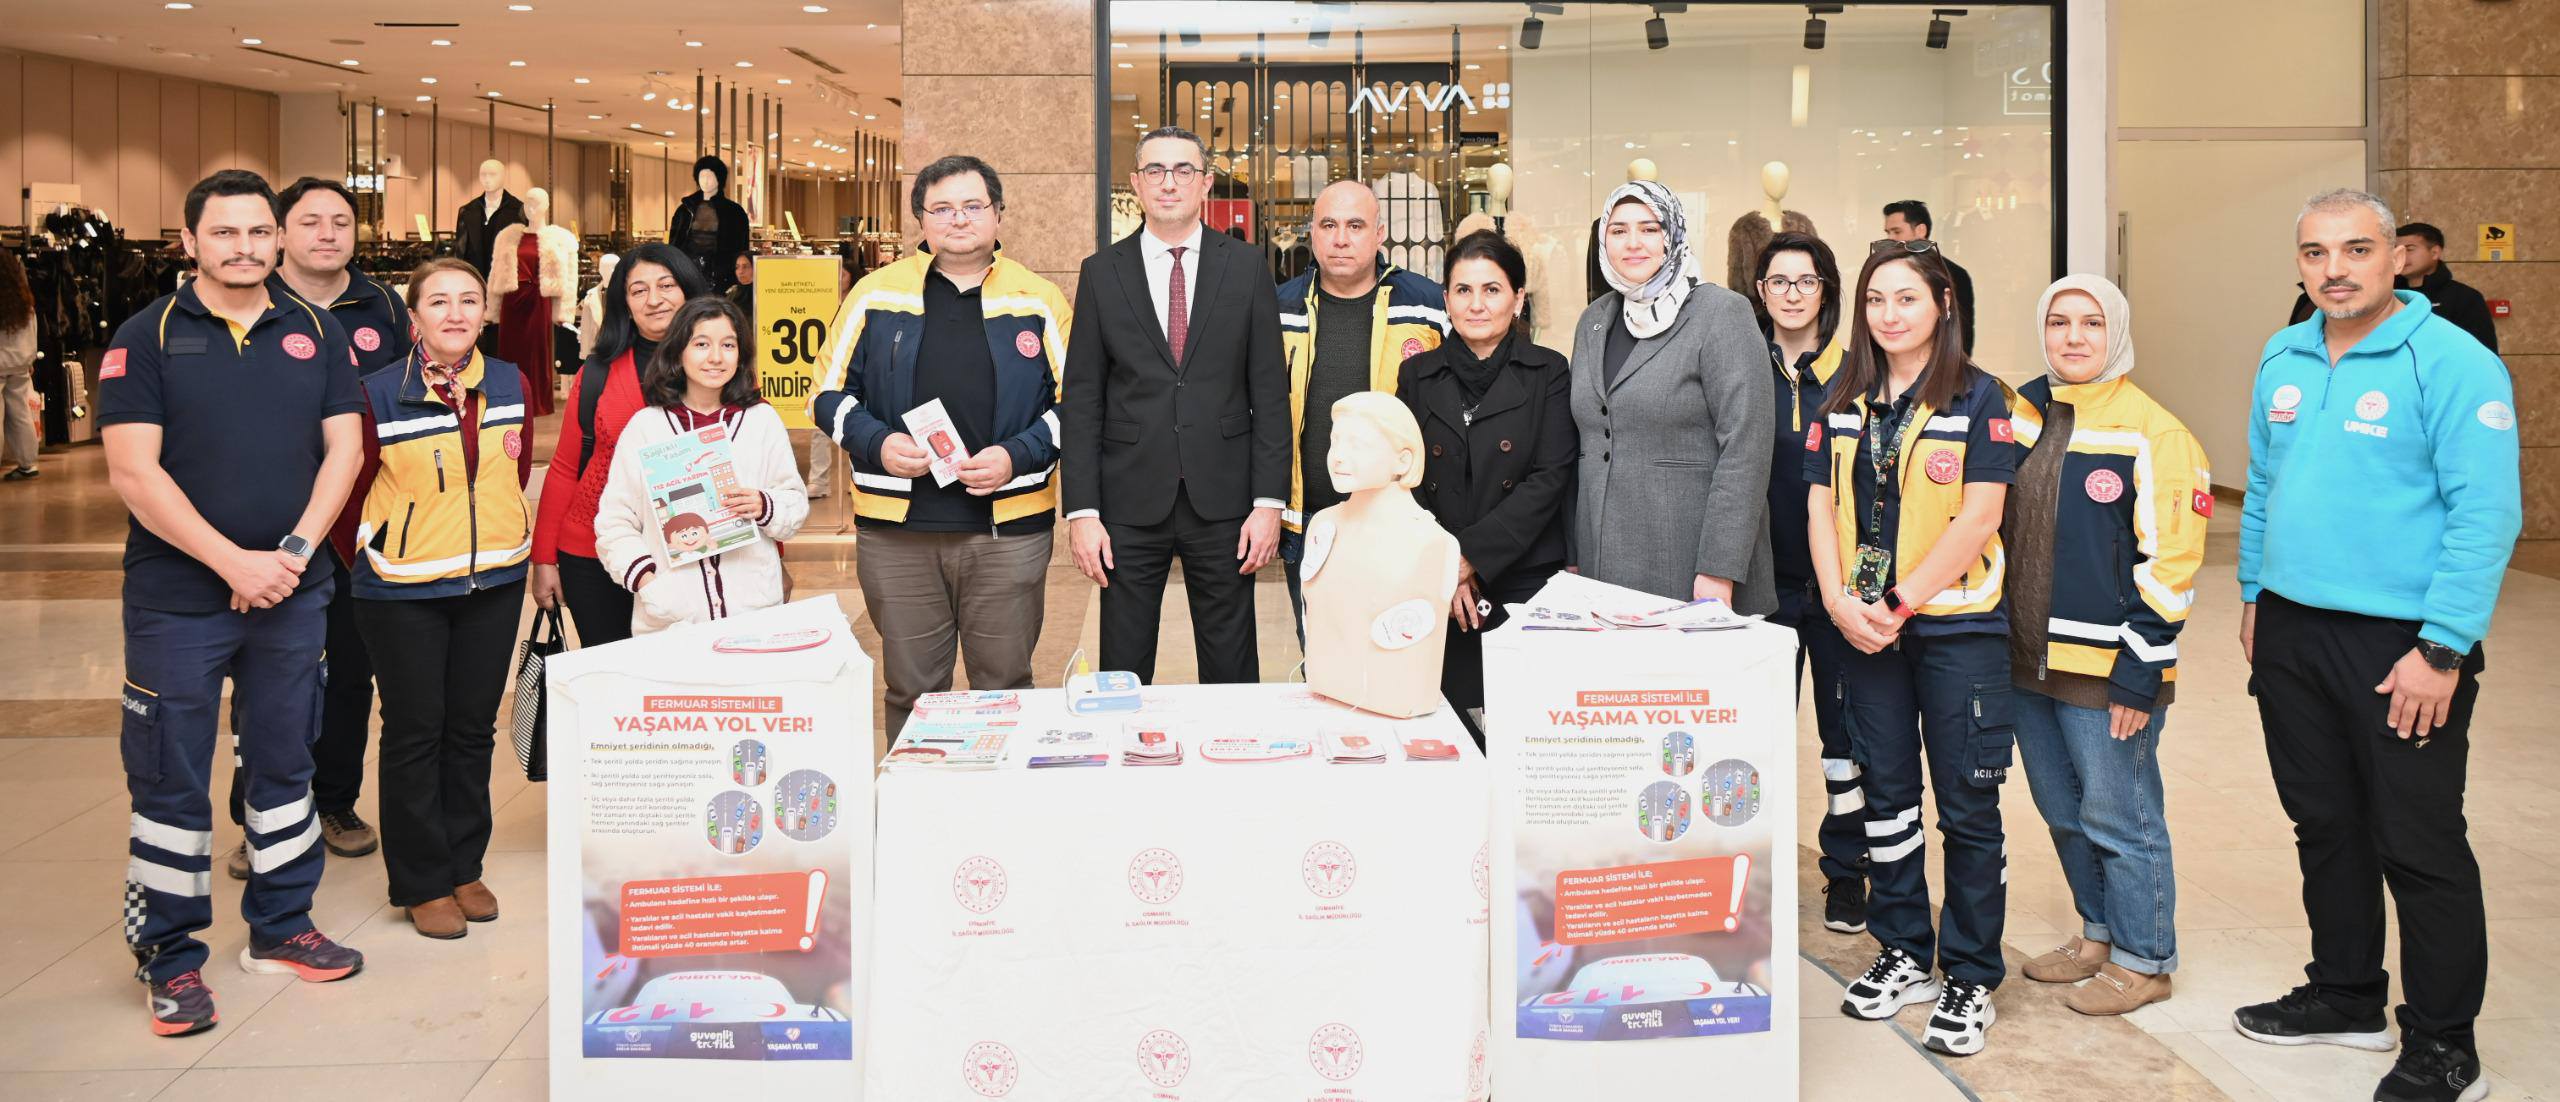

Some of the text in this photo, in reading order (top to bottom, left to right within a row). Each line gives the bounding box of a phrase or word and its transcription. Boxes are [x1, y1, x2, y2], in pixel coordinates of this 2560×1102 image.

[1349, 84, 1476, 113] AVVA
[763, 371, 812, 398] İNDİR
[2344, 420, 2388, 438] UMKE
[651, 697, 775, 710] FERMUAR SİSTEMİ İLE
[1584, 691, 1703, 704] FERMUAR SİSTEMİ İLE
[1548, 709, 1738, 730] YAŞAMA YOL VER!
[614, 716, 813, 736] YAŞAMA YOL VER!
[591, 742, 627, 750] Emniyet
[630, 742, 669, 750] şeridinin
[1525, 736, 1560, 744] Emniyet
[1563, 877, 1603, 885] FERMUAR
[1606, 873, 1636, 882] SİSTEMİ
[628, 887, 670, 896] FERMUAR
[672, 884, 705, 894] SİSTEMİ
[1602, 886, 1632, 894] hedefine
[1660, 880, 1684, 888] şekilde
[629, 900, 666, 908] Ambulans
[730, 895, 755, 903] şekilde
[1618, 899, 1645, 907] hastalar
[1665, 891, 1712, 901] kaybetmeden
[736, 908, 786, 917] kaybetmeden
[1661, 913, 1686, 921] hayatta
[693, 931, 729, 939] hastaların
[731, 929, 758, 937] hayatta
[661, 942, 682, 950] yüzde
[1693, 1018, 1716, 1027] YAŞAMA
[768, 1043, 792, 1051] YAŞAMA
[804, 1042, 818, 1050] VER!
